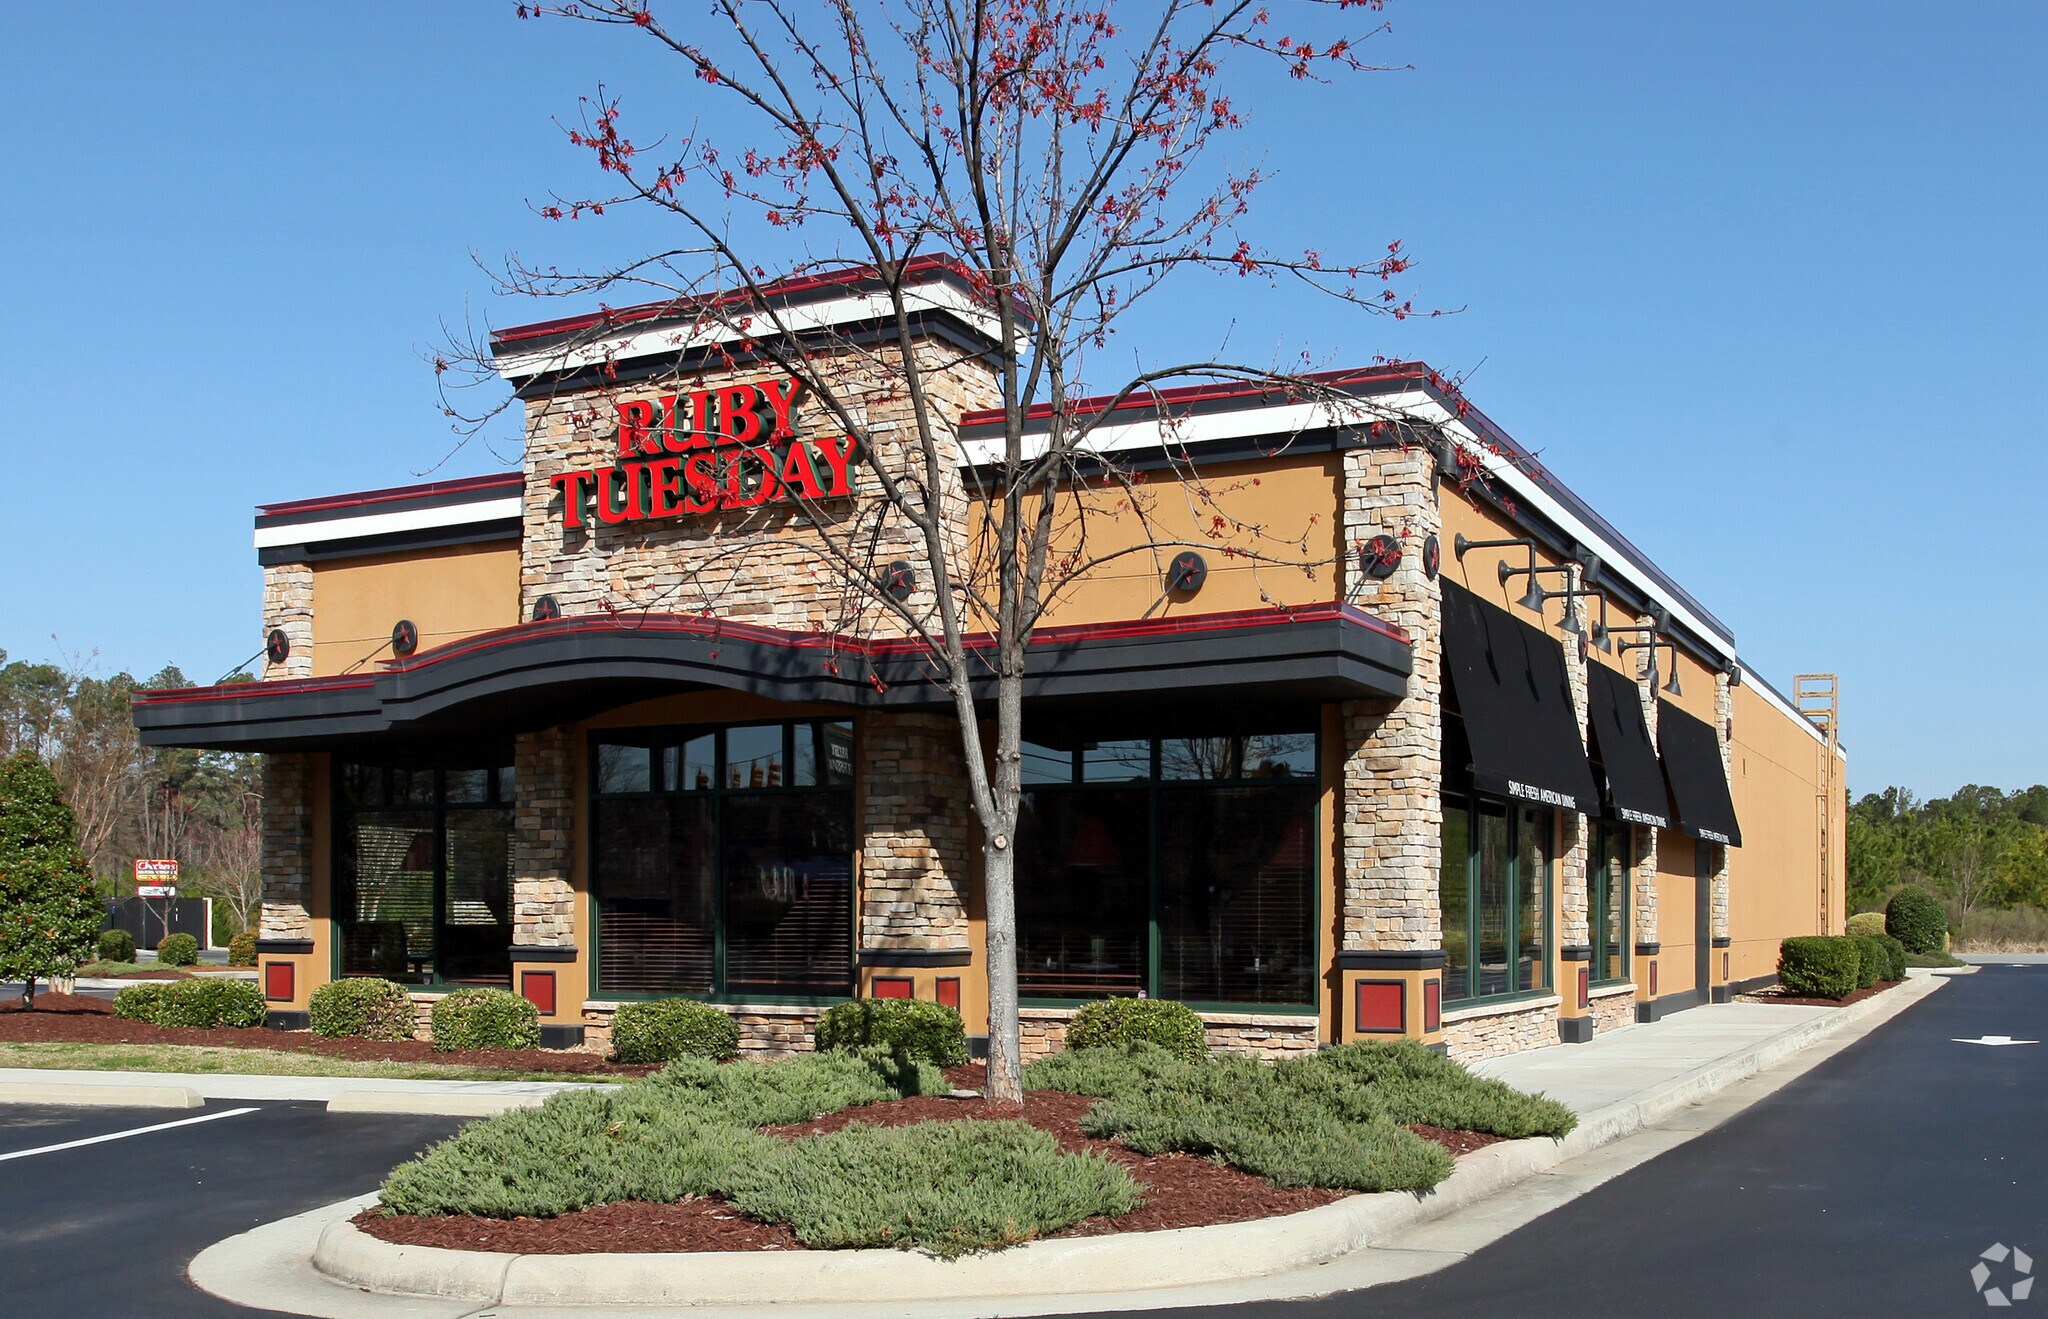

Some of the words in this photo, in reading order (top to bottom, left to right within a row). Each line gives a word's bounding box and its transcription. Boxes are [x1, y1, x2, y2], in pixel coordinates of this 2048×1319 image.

[614, 377, 802, 459] RUBY
[550, 436, 859, 529] TUESDAY
[1508, 780, 1525, 798] SIMPLE
[1525, 785, 1540, 801] FRESH
[1540, 788, 1562, 805] AMERICAN
[1561, 794, 1576, 809] DINING
